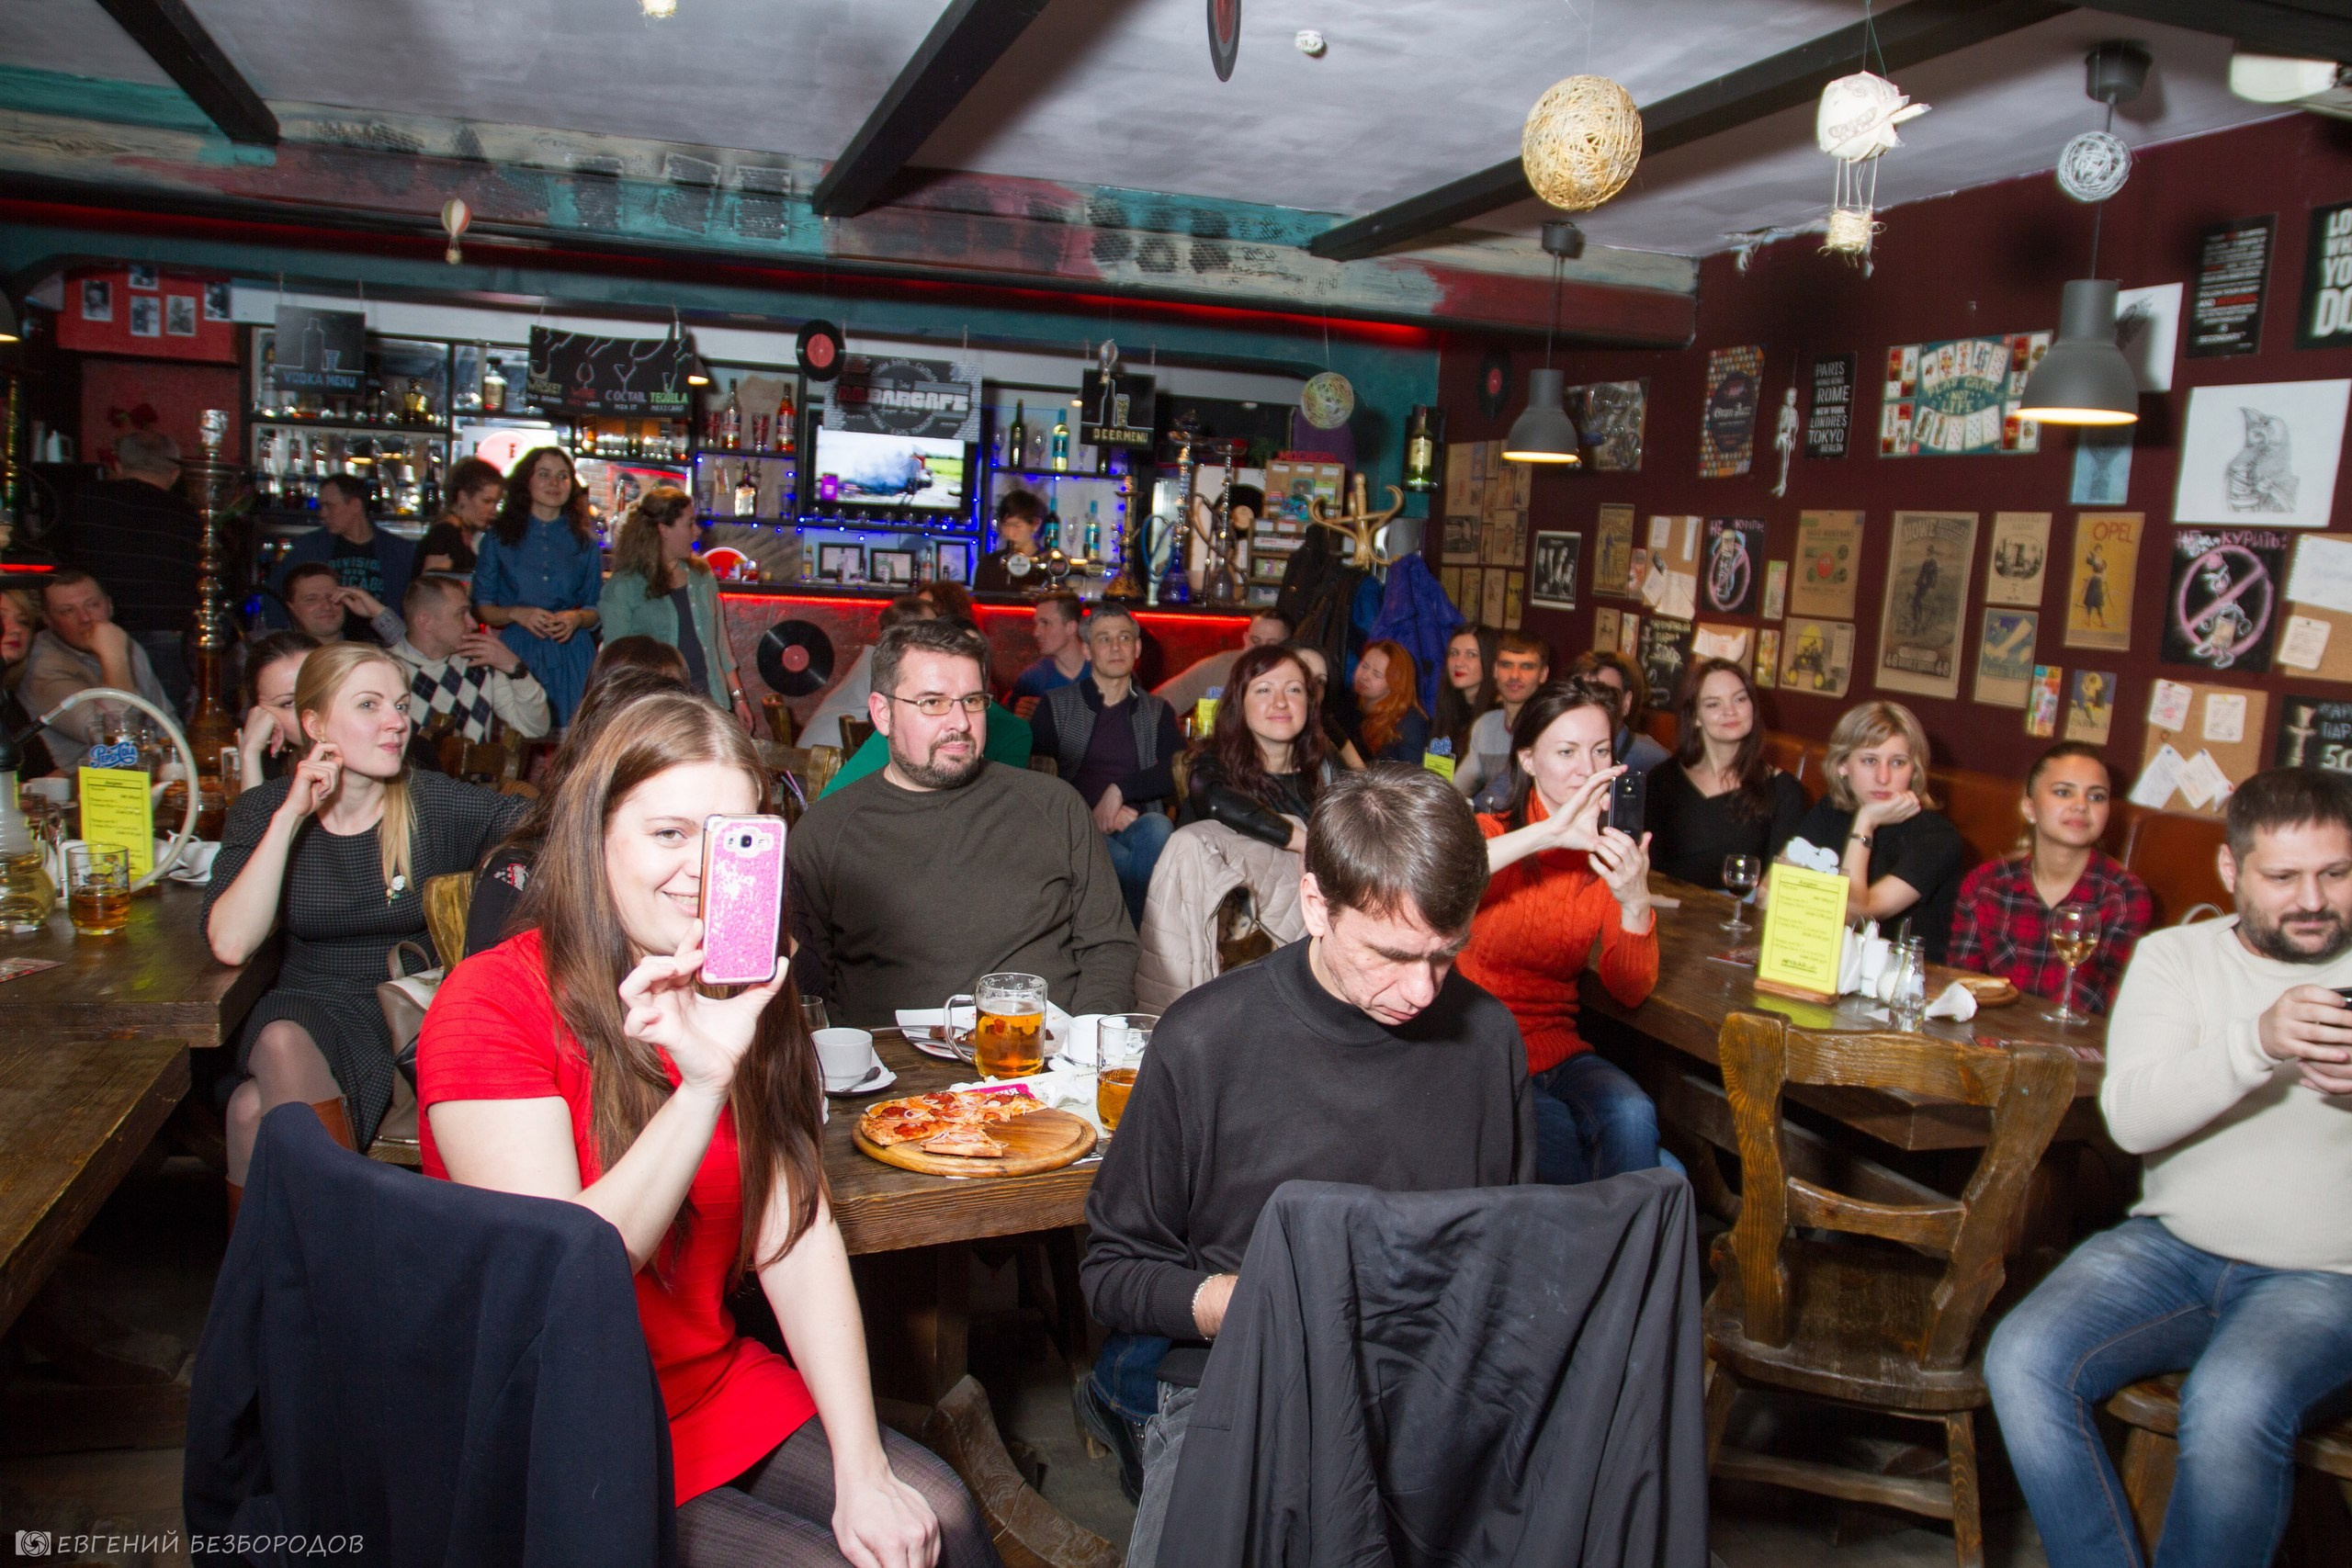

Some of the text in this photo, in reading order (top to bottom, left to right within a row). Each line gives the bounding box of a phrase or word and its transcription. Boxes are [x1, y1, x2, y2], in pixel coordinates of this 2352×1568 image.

[1815, 360, 1846, 378] PARIS
[283, 371, 356, 388] VODKA MENU
[1929, 378, 1997, 396] PLAY GAME
[605, 389, 647, 402] COCTAIL
[650, 391, 688, 404] TEQUILA
[1817, 384, 1851, 403] ROME
[1951, 389, 1969, 400] NOT
[1941, 400, 1974, 412] LIFE
[1810, 414, 1848, 429] LONDRES
[1808, 428, 1845, 445] TOKYO
[1820, 443, 1844, 453] BERLIN
[1902, 516, 1937, 542] HOWE
[2092, 520, 2133, 545] OPEL
